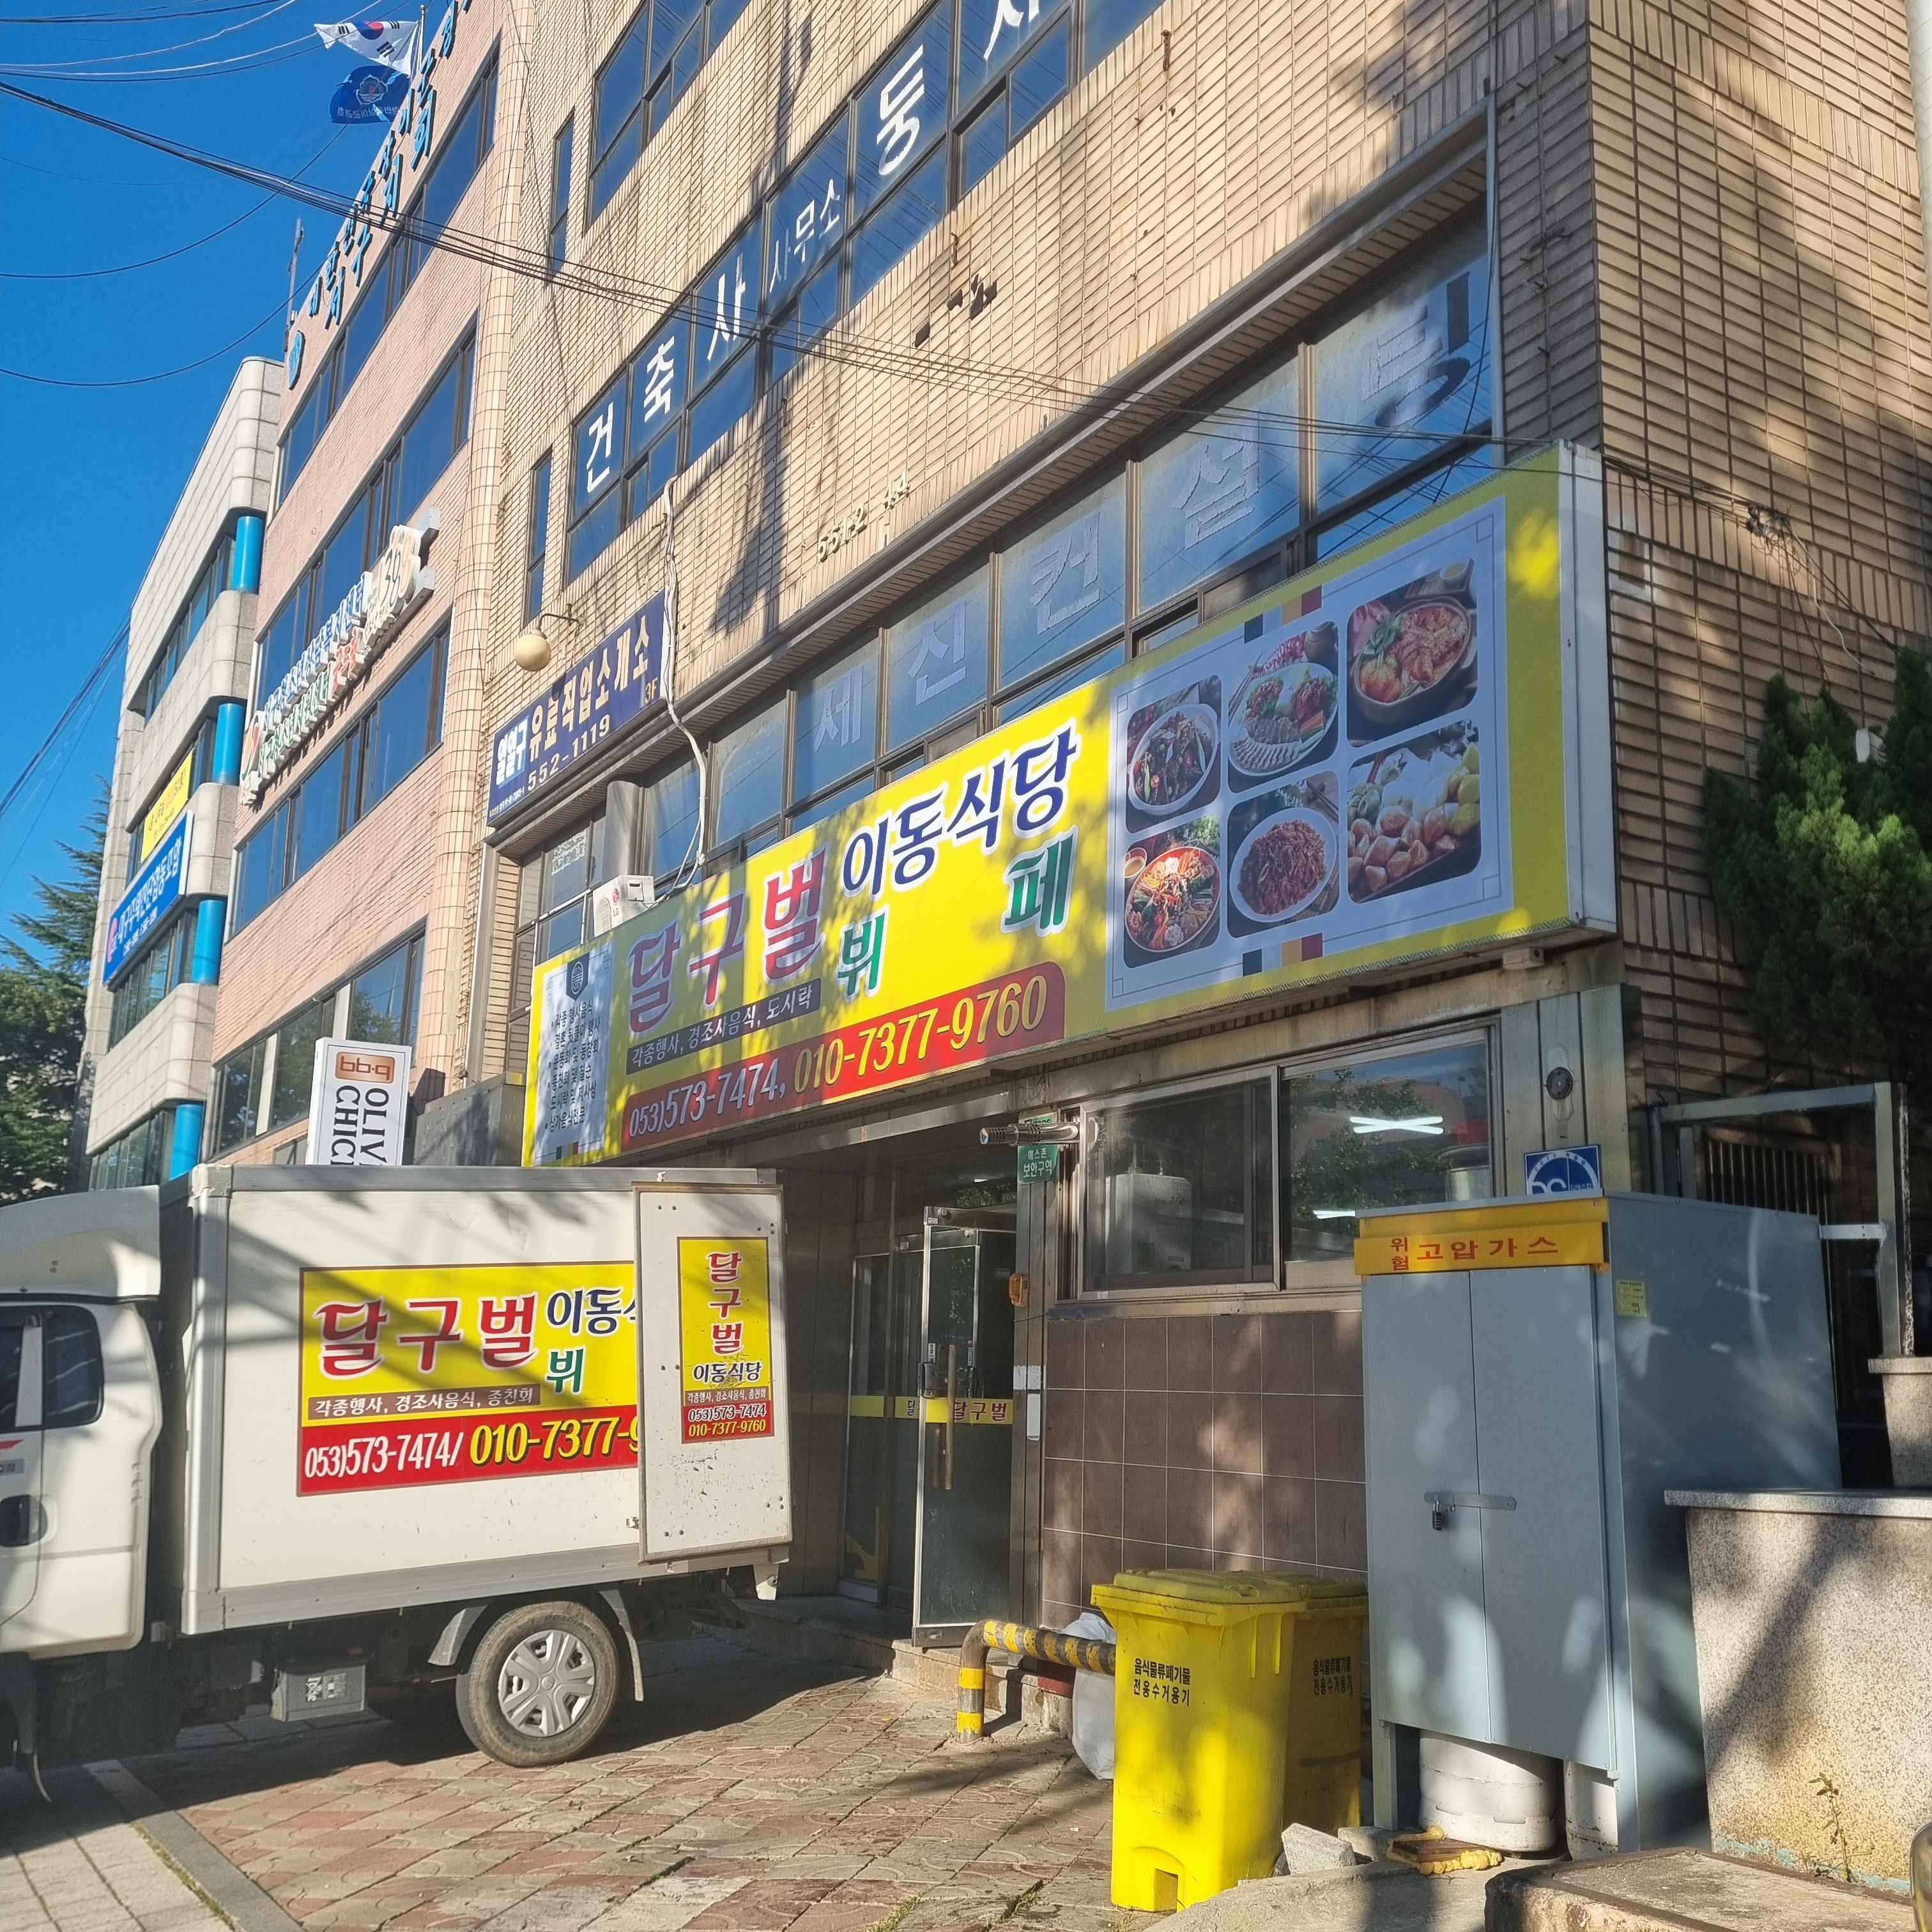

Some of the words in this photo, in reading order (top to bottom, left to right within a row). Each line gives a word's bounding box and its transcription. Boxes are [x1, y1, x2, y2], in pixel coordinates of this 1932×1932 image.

[308, 0, 471, 317] 대한민국상이군경
[585, 254, 747, 493] 건축사
[770, 180, 840, 292] 사무소
[529, 615, 650, 763] 유료직업소개소
[645, 677, 657, 703] 3F
[527, 714, 610, 791] 552-1119
[629, 846, 826, 1034] 달구벌
[843, 726, 1076, 894] 이동식당
[613, 908, 619, 917] LG
[632, 1034, 683, 1068] 각종행사,
[688, 1008, 761, 1049] 경조사음식,
[767, 985, 814, 1018] 도시락
[553, 1049, 570, 1070] 운동회
[572, 1046, 578, 1064] 및
[580, 1038, 599, 1061] 동창회
[630, 1064, 785, 1138] 053)573-7474,
[795, 975, 1047, 1093] 010-7377-9760
[552, 1070, 569, 1091] 종친회
[571, 1066, 577, 1084] 및
[551, 1090, 568, 1110] 도시락
[570, 1087, 576, 1105] 및
[578, 1080, 597, 1101] 제사상
[360, 1088, 389, 1165] OLIV
[1028, 1147, 1046, 1160] 에스존
[1535, 1153, 1556, 1171] CCTV
[1023, 1160, 1052, 1177] 보안구역
[1391, 1238, 1409, 1271] 위험
[1416, 1236, 1559, 1261] 고압가스
[707, 1252, 743, 1354] 달구벌
[316, 1293, 539, 1378] 달구벌
[548, 1289, 636, 1335] 이동
[546, 1348, 584, 1393] 뷔
[694, 1361, 762, 1383] 이동식당
[314, 1397, 388, 1417] 각종행사,
[395, 1392, 480, 1413] 경조사음식,
[487, 1388, 533, 1407] 종친회
[687, 1391, 714, 1403] 각종행사,
[716, 1389, 747, 1401] 경조사음식,
[749, 1388, 766, 1399] 종친회
[689, 1404, 766, 1422] 053)573-7474
[954, 1400, 1007, 1422] 달구벌
[689, 1420, 766, 1437] 010-7377-9760
[305, 1432, 464, 1478] 053)573-7474/
[1134, 1658, 1191, 1685] 음식물류폐기물
[1313, 1657, 1351, 1676] 음식물류폐기물
[1133, 1678, 1190, 1706] 전용수거용기
[1314, 1677, 1352, 1696] 전용수거용기
